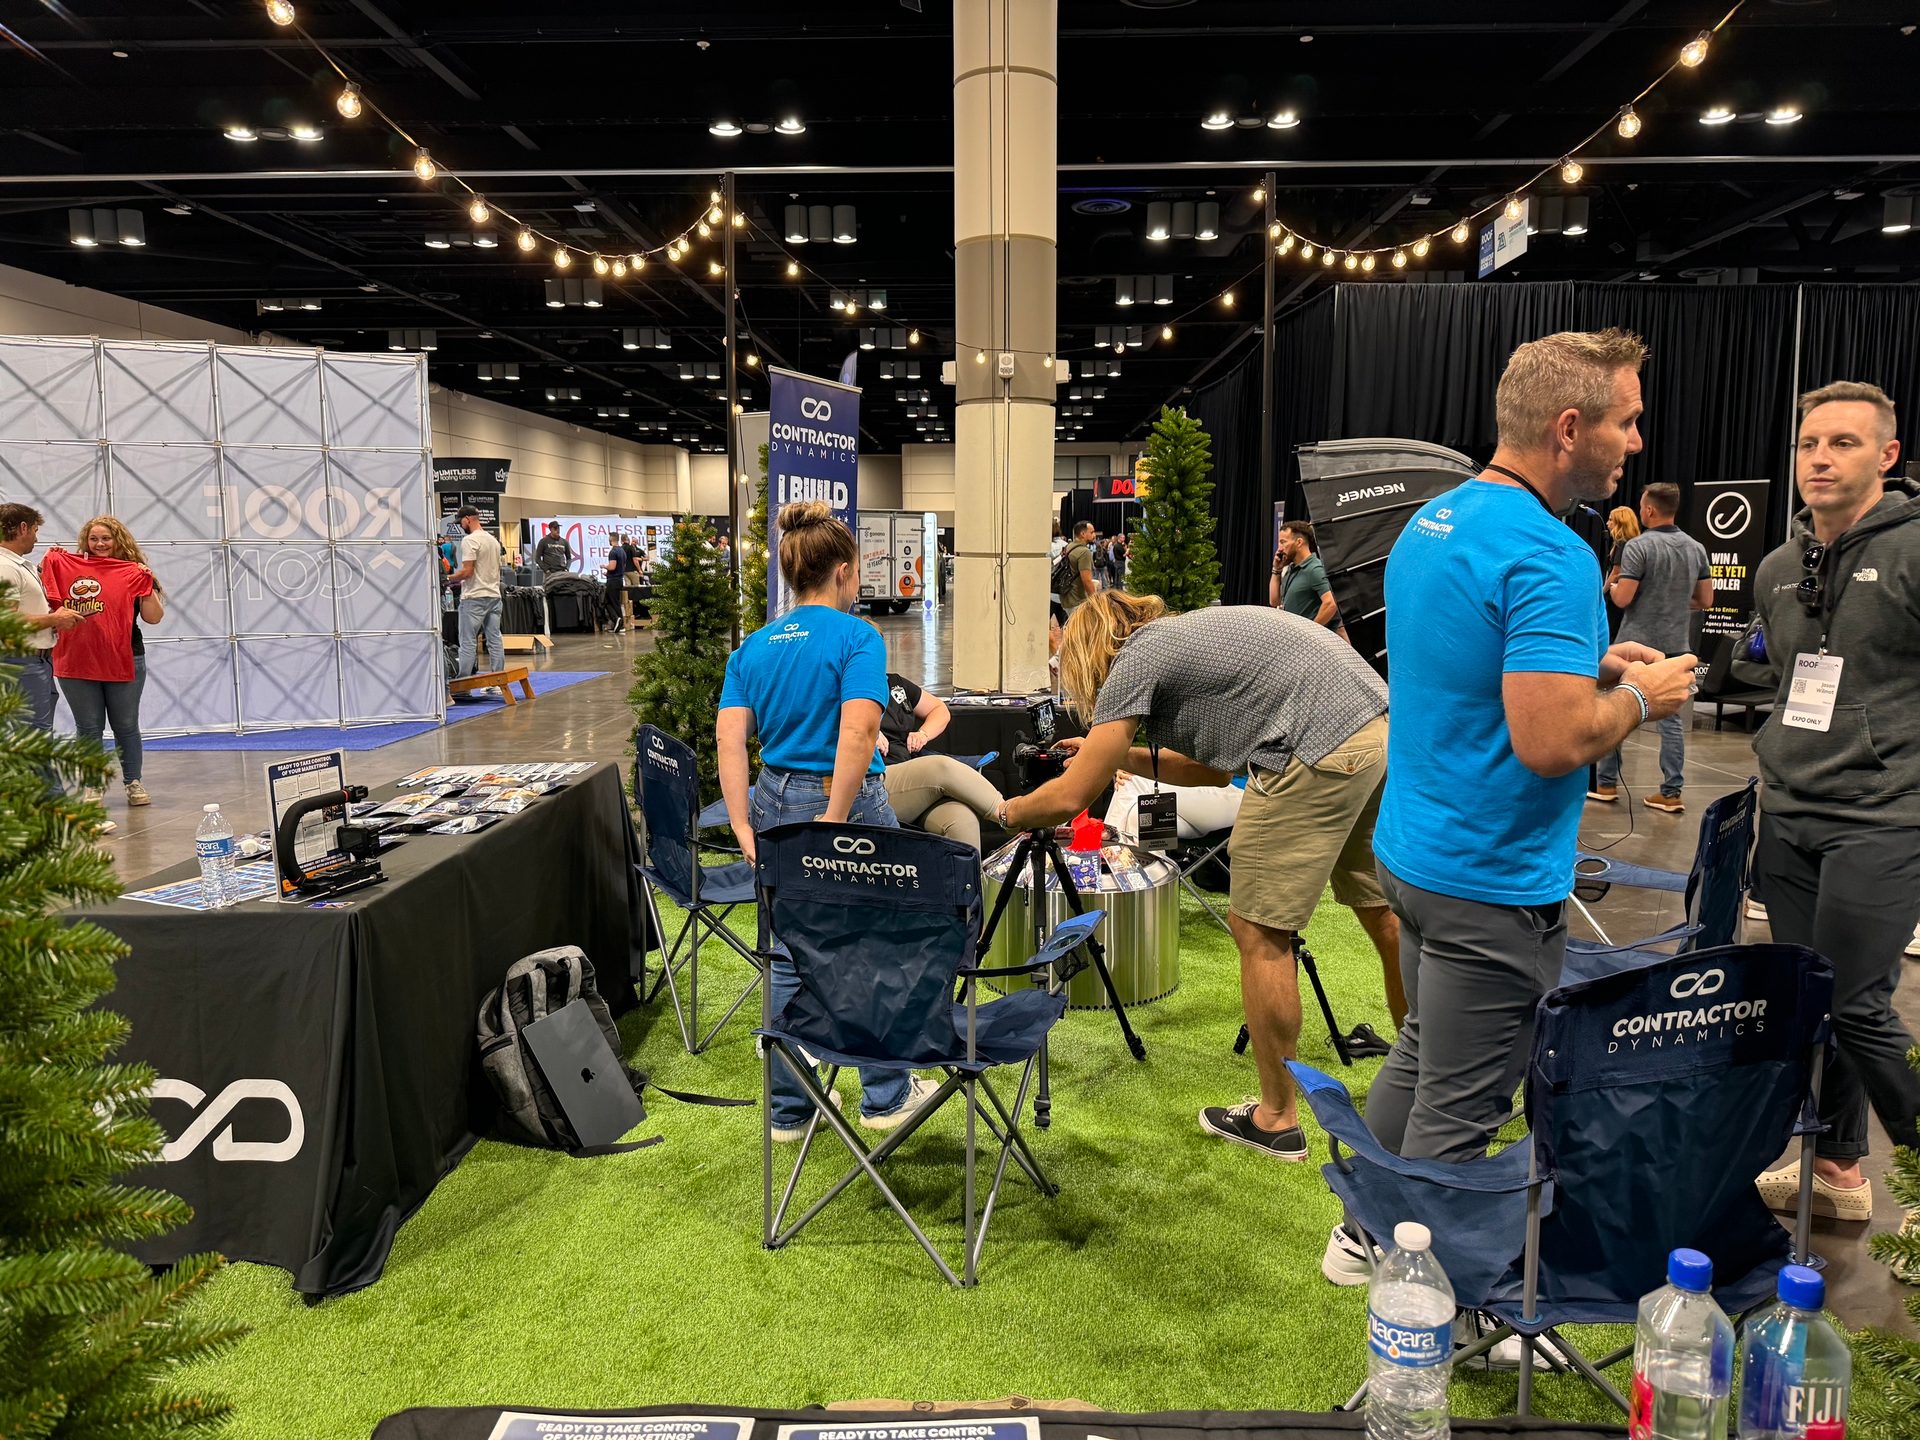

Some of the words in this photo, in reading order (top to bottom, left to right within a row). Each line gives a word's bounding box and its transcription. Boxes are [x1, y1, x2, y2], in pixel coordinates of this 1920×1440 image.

[772, 422, 856, 451] CONTRACTOR
[771, 441, 856, 464] DYNAMICS
[778, 474, 786, 503] I
[791, 475, 848, 510] BUILD
[1338, 482, 1406, 503] NEEWER
[1711, 552, 1730, 565] WIN
[1731, 552, 1738, 565] A
[1725, 566, 1746, 578] YETI
[1712, 578, 1740, 591] OOLER
[1791, 715, 1806, 723] EXPO
[801, 855, 918, 878] CONTRACTOR
[804, 869, 920, 889] DYNAMICS
[1612, 999, 1768, 1038] CONTRACTOR
[1607, 1020, 1765, 1054] DYNAMICS
[1370, 1313, 1435, 1348] niagara
[1787, 1385, 1843, 1424] FIJI
[536, 1422, 584, 1433] READY
[585, 1423, 604, 1433] TO
[606, 1424, 641, 1433] TAKE
[643, 1423, 708, 1433] CONTROL
[818, 1430, 865, 1440] READY
[867, 1430, 891, 1440] TO
[891, 1428, 926, 1439] TAKE
[926, 1426, 996, 1438] CONTROL
